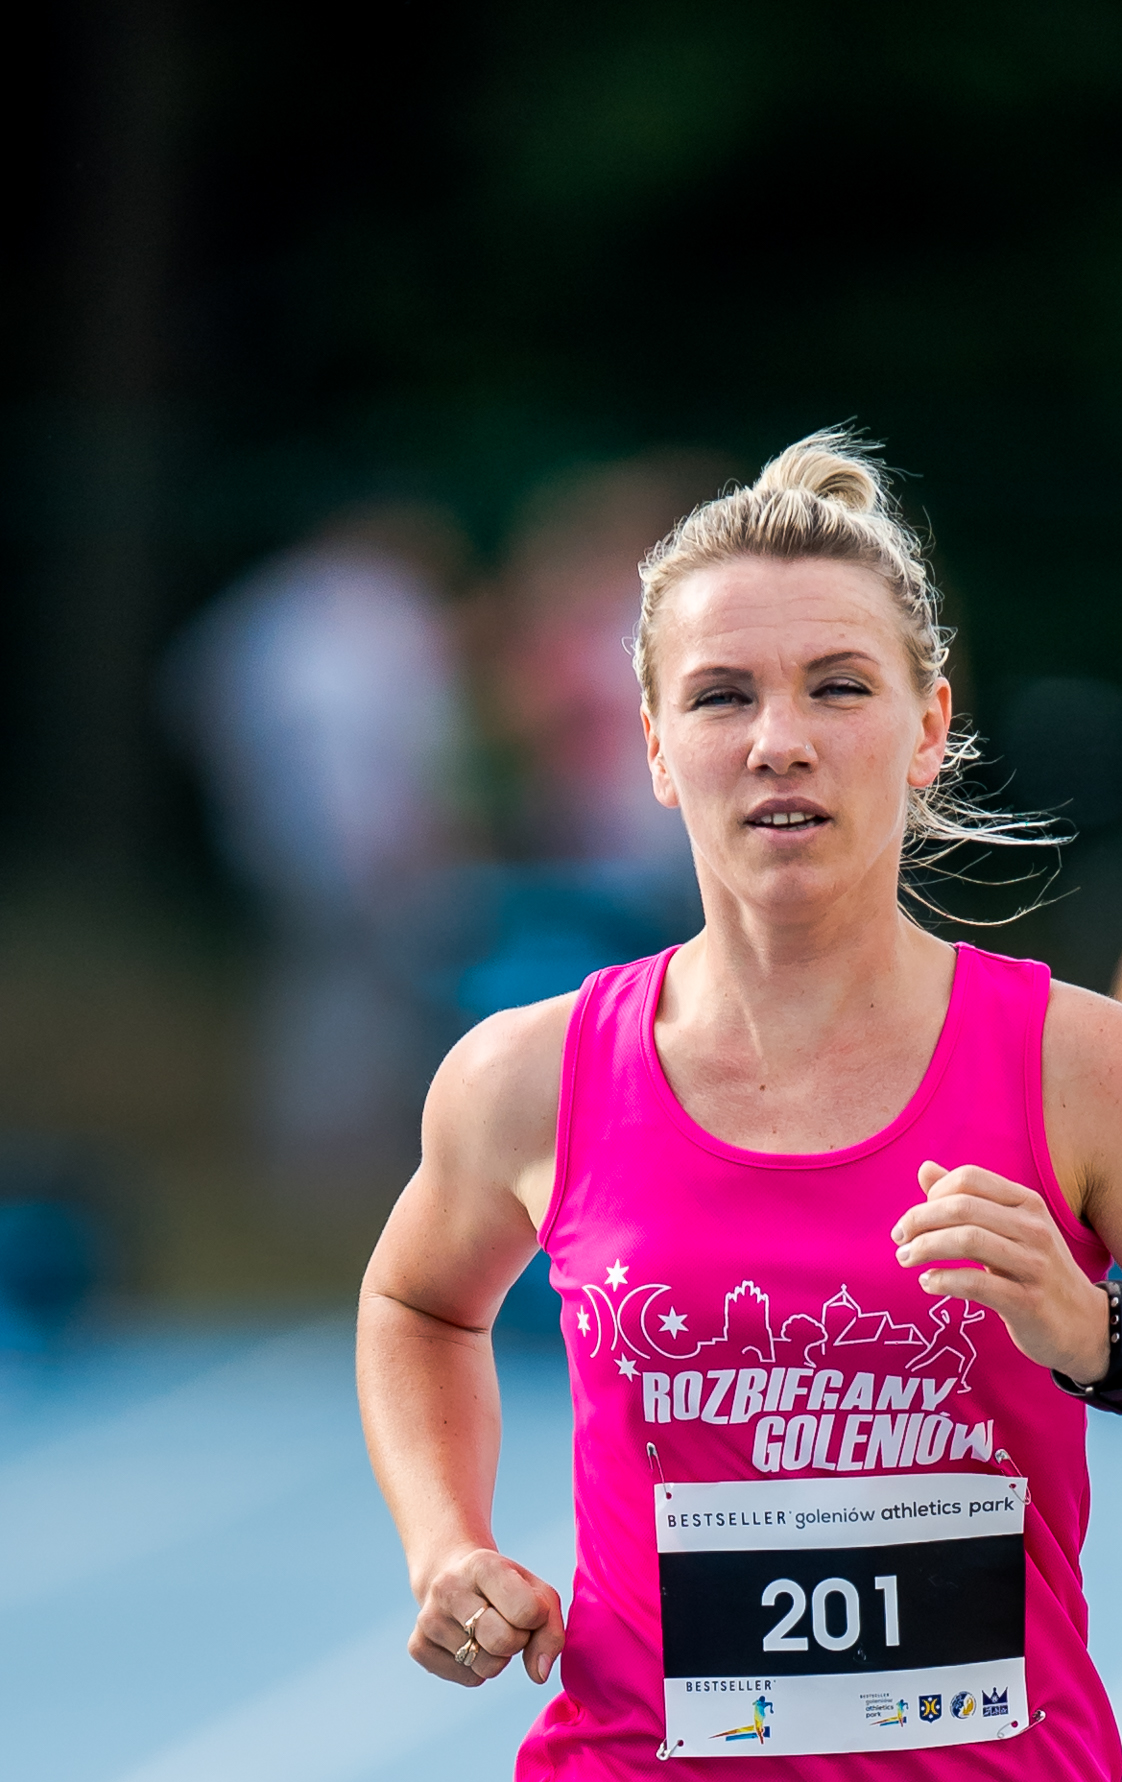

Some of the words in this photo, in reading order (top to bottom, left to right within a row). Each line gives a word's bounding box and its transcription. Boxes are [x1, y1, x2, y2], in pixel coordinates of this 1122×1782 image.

[752, 1411, 994, 1473] GOLENIÓW
[667, 1510, 787, 1528] BESTSELLER
[795, 1507, 875, 1530] goleniów
[881, 1499, 962, 1521] athletics
[968, 1496, 1015, 1518] park
[761, 1574, 900, 1652] 201
[685, 1680, 772, 1693] BESTSELLER
